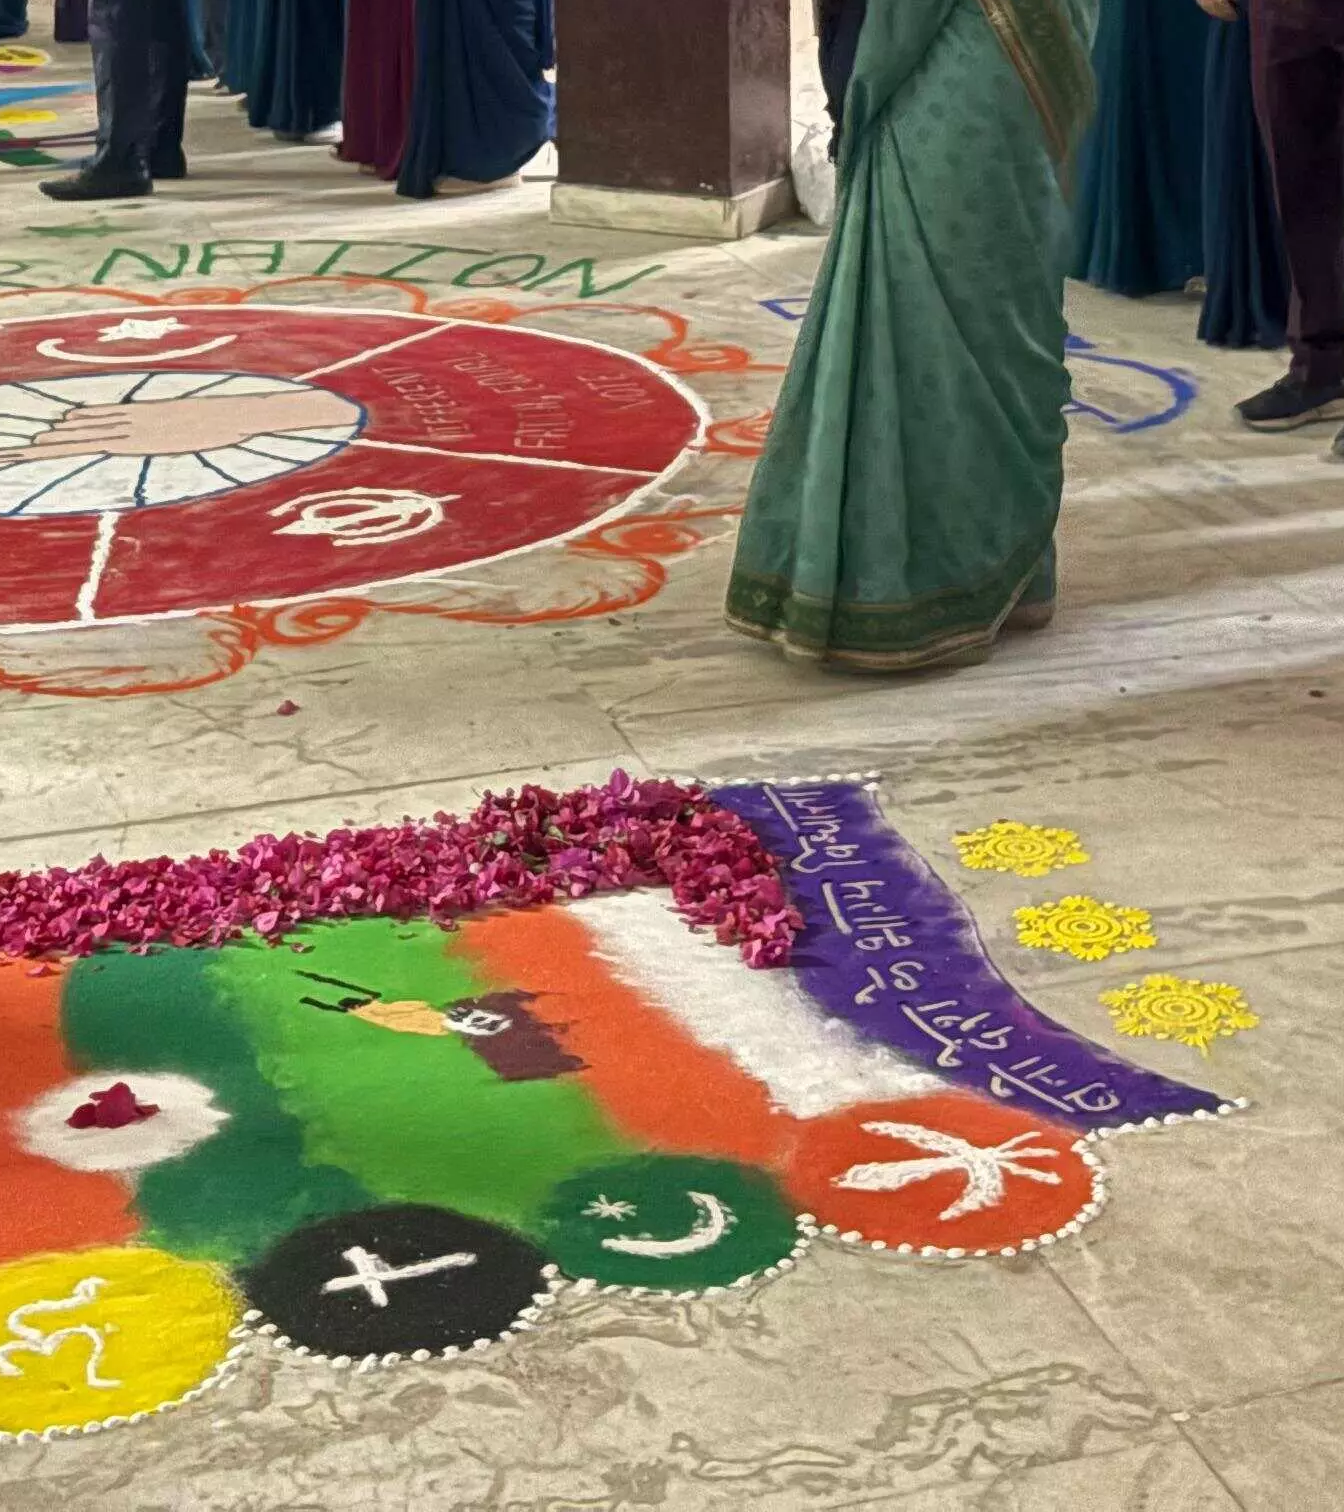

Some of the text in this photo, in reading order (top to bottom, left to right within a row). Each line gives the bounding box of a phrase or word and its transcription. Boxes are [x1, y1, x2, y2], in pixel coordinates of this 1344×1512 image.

[89, 236, 666, 300] NATION
[371, 365, 477, 441] DIFFERENT
[575, 373, 655, 410] VOTE
[822, 879, 913, 951] भाग्य
[855, 960, 925, 1004] के
[989, 1056, 1120, 1113] बनो
